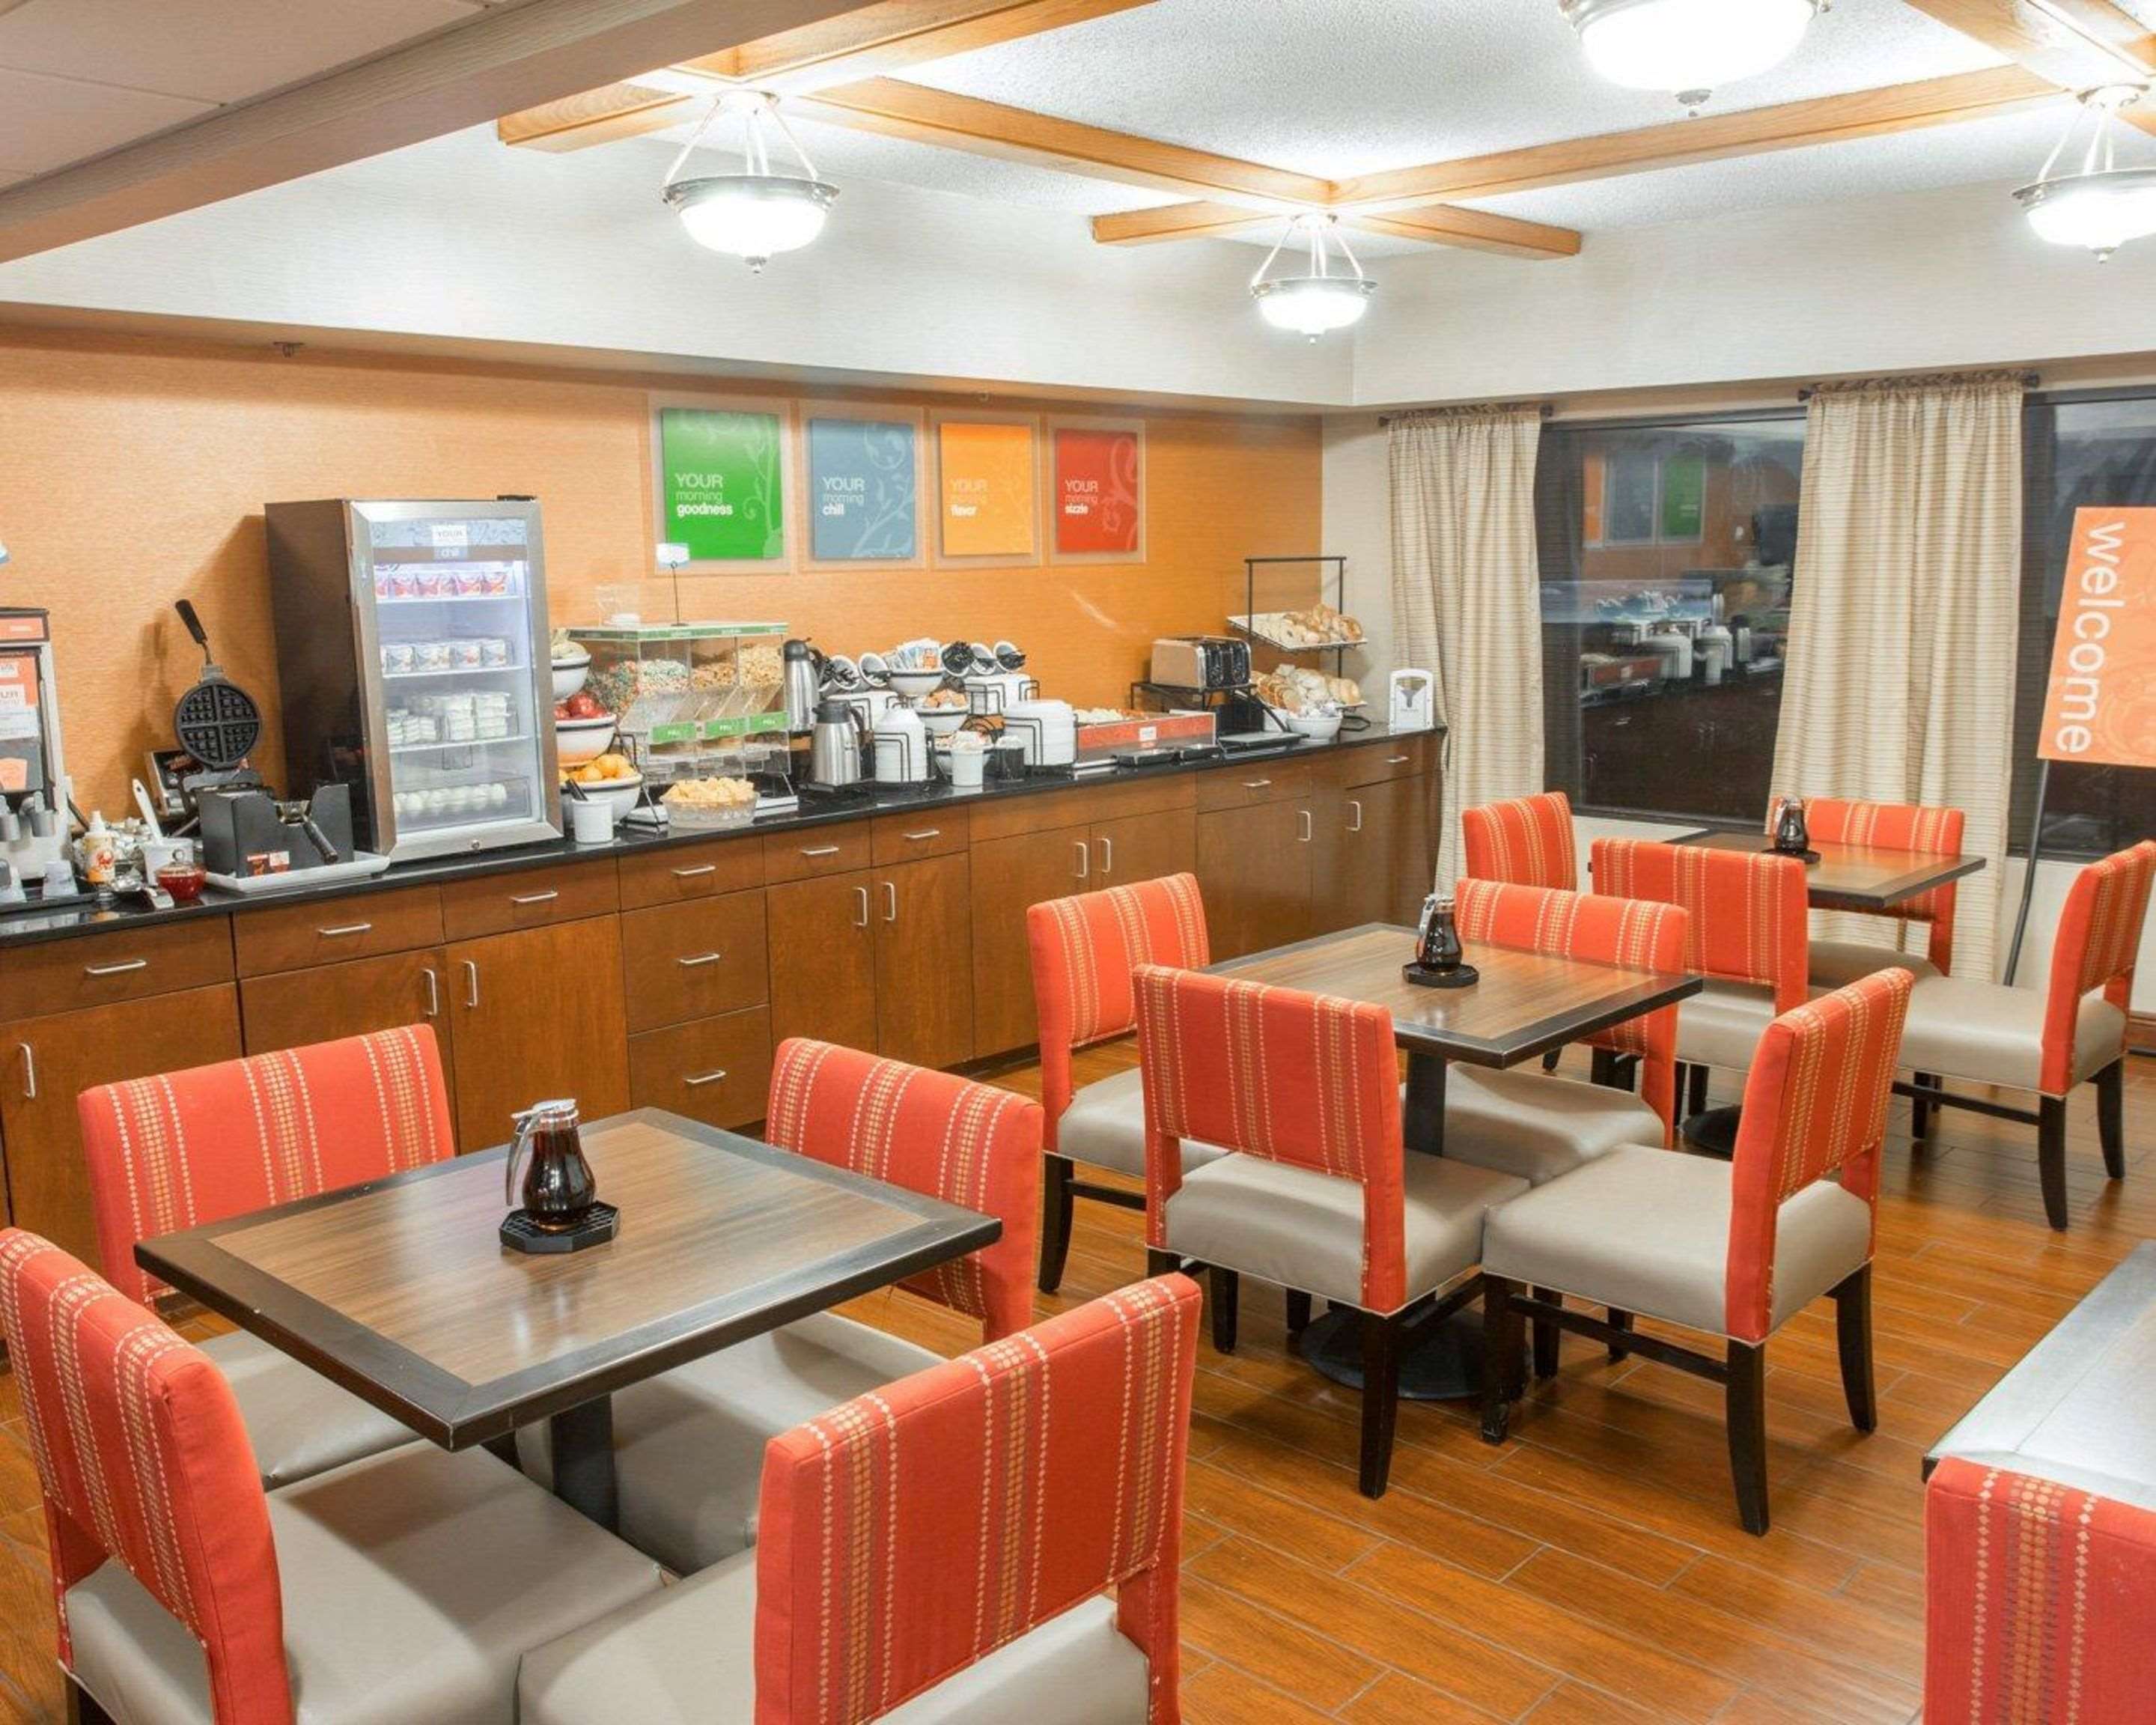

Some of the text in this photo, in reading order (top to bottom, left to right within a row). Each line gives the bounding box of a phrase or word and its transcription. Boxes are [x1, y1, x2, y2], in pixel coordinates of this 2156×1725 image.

[674, 473, 723, 488] YOUR
[822, 477, 865, 491] YOUR
[1065, 479, 1098, 493] YOUR
[675, 490, 723, 505] morning
[677, 502, 733, 518] goodness
[822, 502, 845, 516] chill
[2056, 522, 2126, 753] welcome
